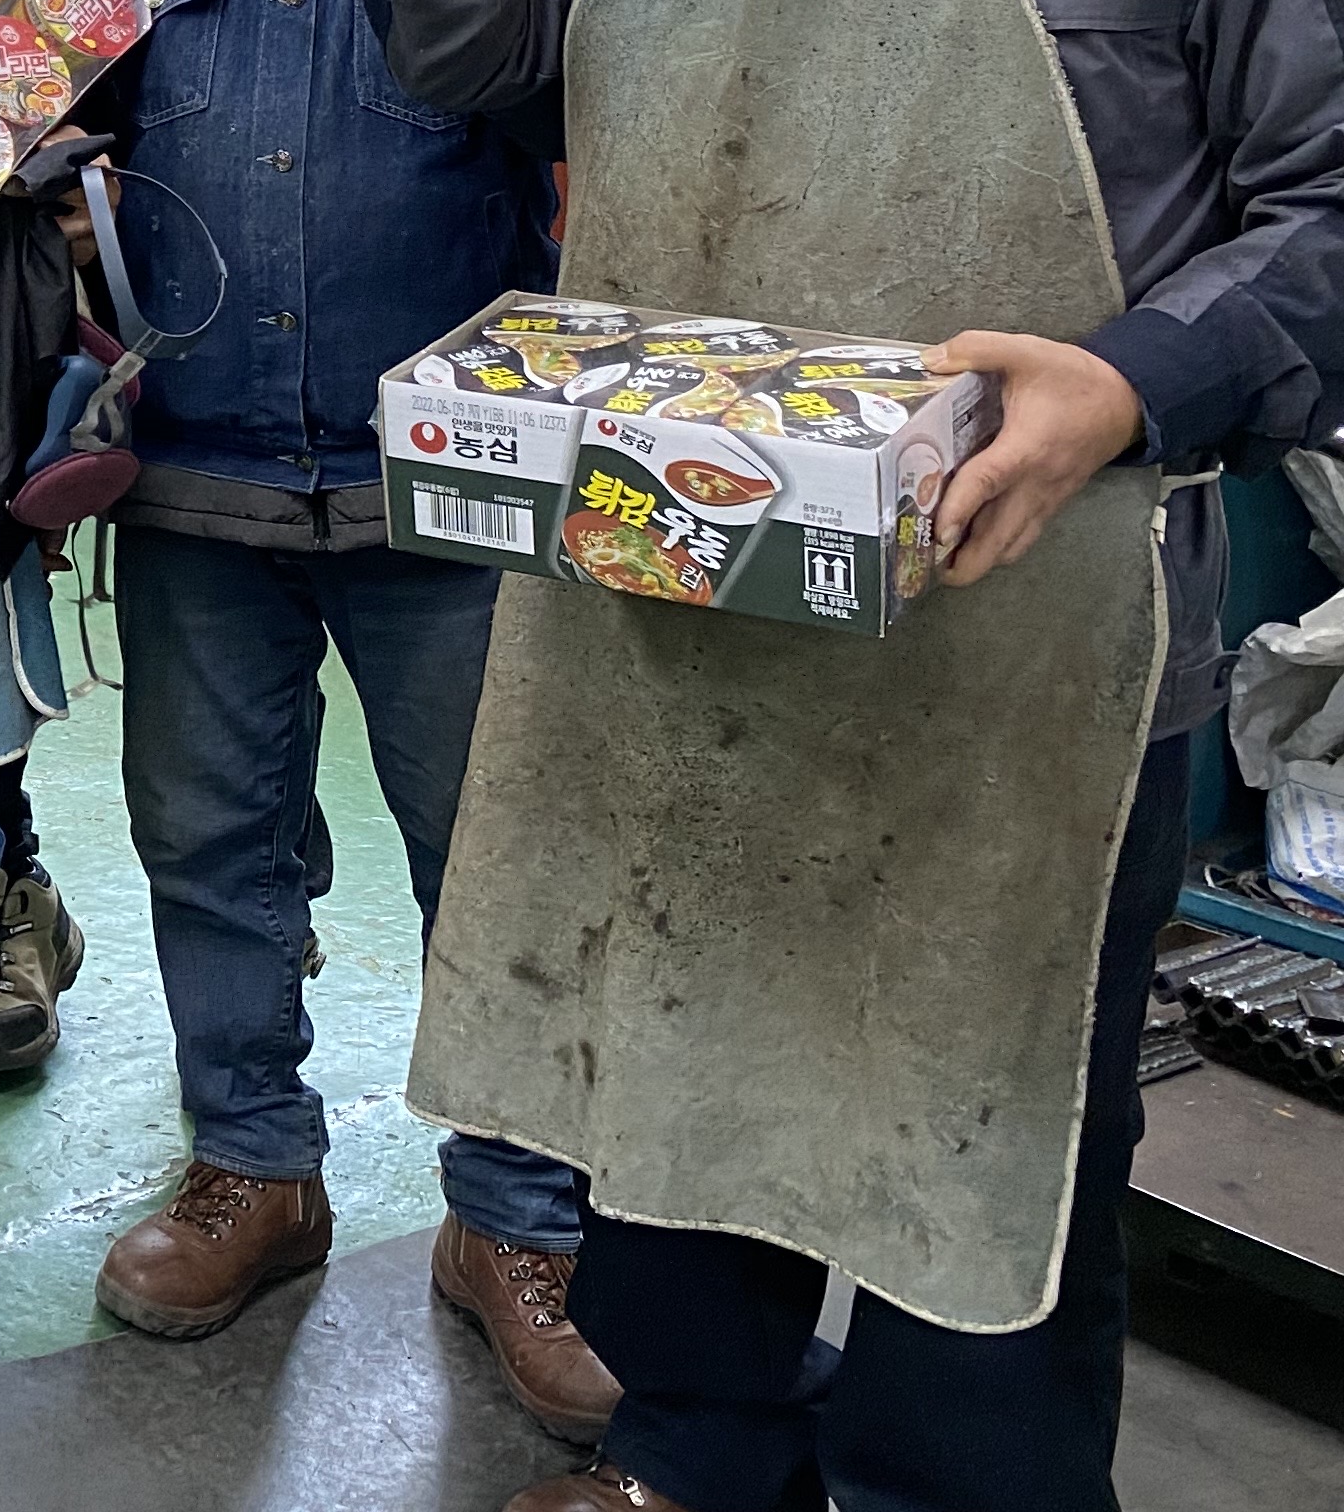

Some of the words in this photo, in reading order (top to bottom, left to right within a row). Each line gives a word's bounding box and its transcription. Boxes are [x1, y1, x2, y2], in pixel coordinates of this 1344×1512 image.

[412, 395, 464, 417] 2022.06.09
[451, 418, 483, 431] 인생을
[485, 422, 518, 438] 맛있게
[452, 432, 518, 464] 농심
[619, 430, 656, 454] 농심
[578, 469, 657, 530] 튀김
[652, 507, 730, 570] 우동
[680, 563, 704, 590] 컵
